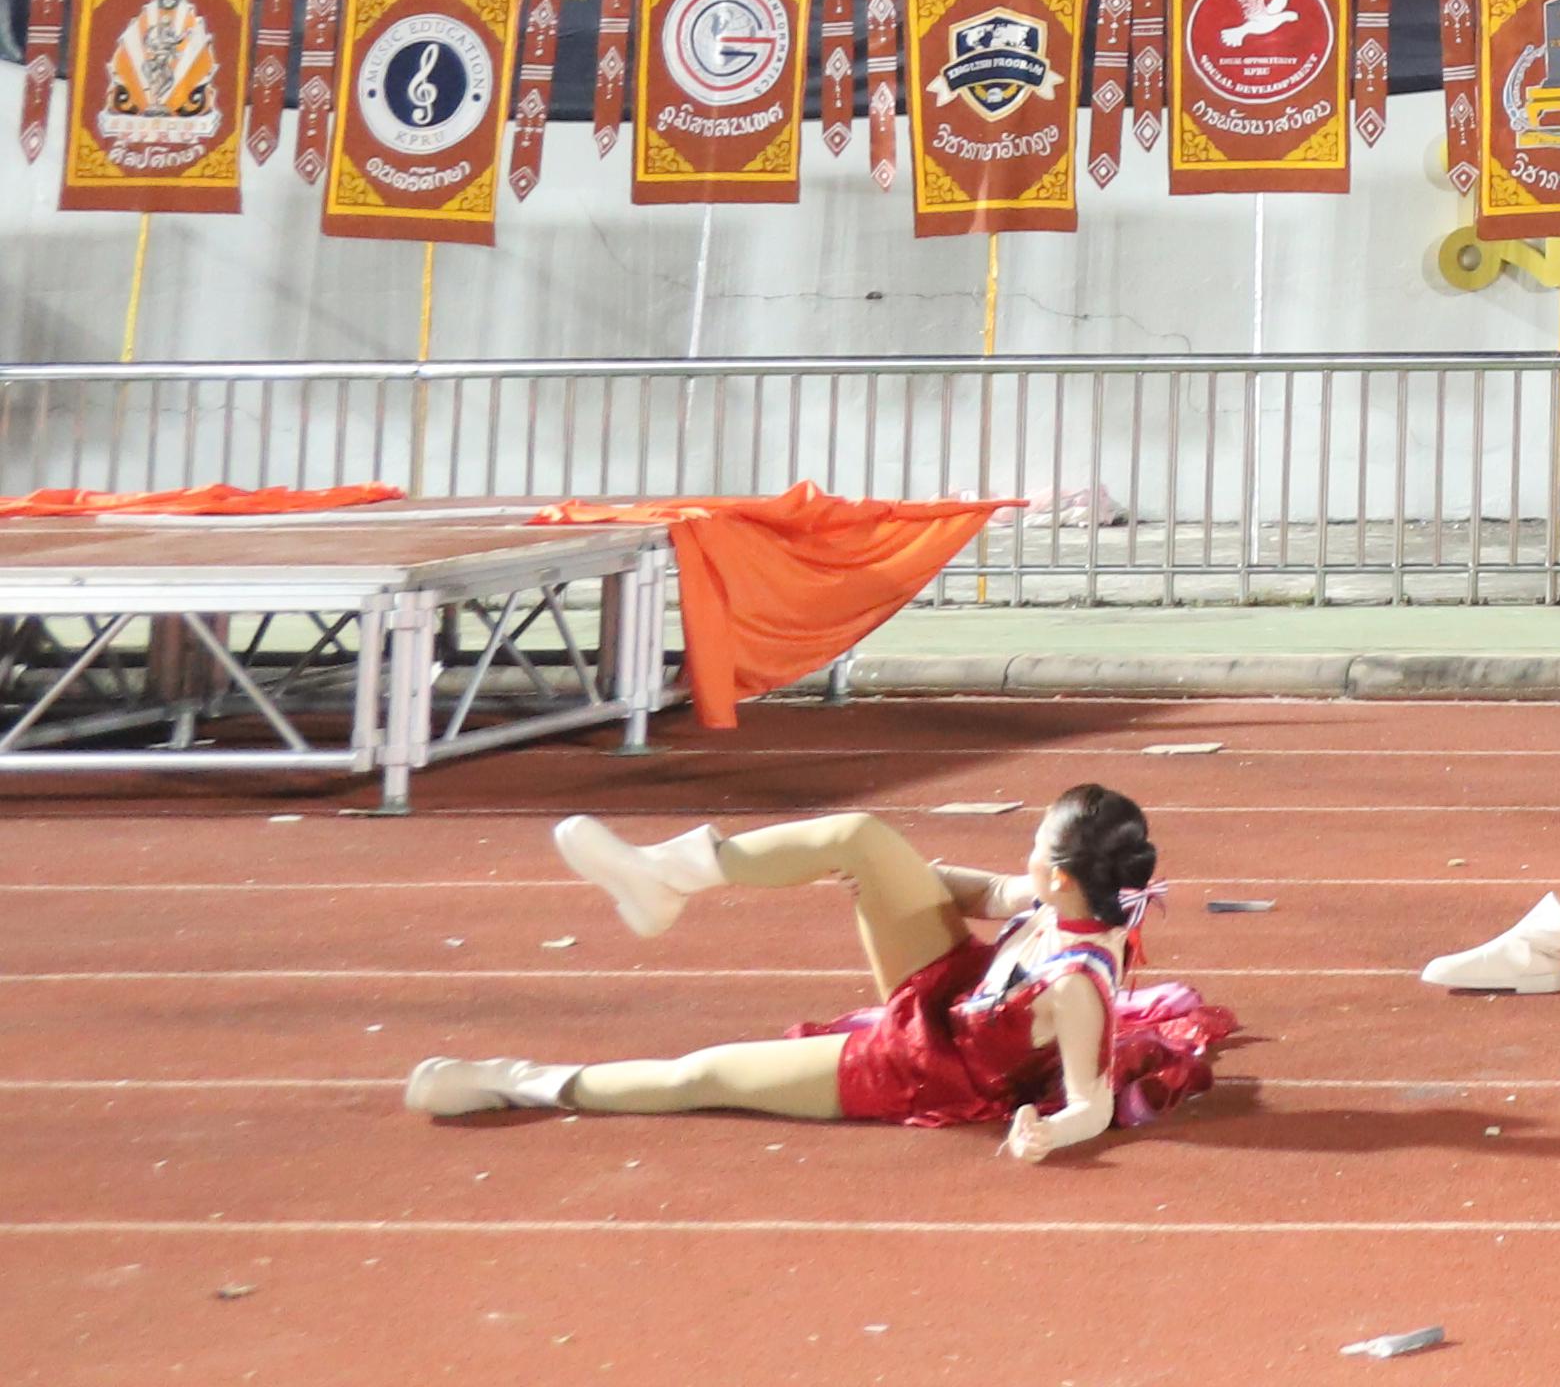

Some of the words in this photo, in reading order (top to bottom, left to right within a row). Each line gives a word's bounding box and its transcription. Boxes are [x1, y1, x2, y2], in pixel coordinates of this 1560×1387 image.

[366, 31, 404, 83] MUSIC
[409, 20, 486, 90] EDUCATION
[946, 57, 993, 80] ENGLISH
[993, 56, 1045, 77] PROGRAM
[1200, 54, 1234, 90] SOCIAL
[1235, 53, 1319, 95] DEVELOPMENT
[394, 129, 446, 146] KPRU
